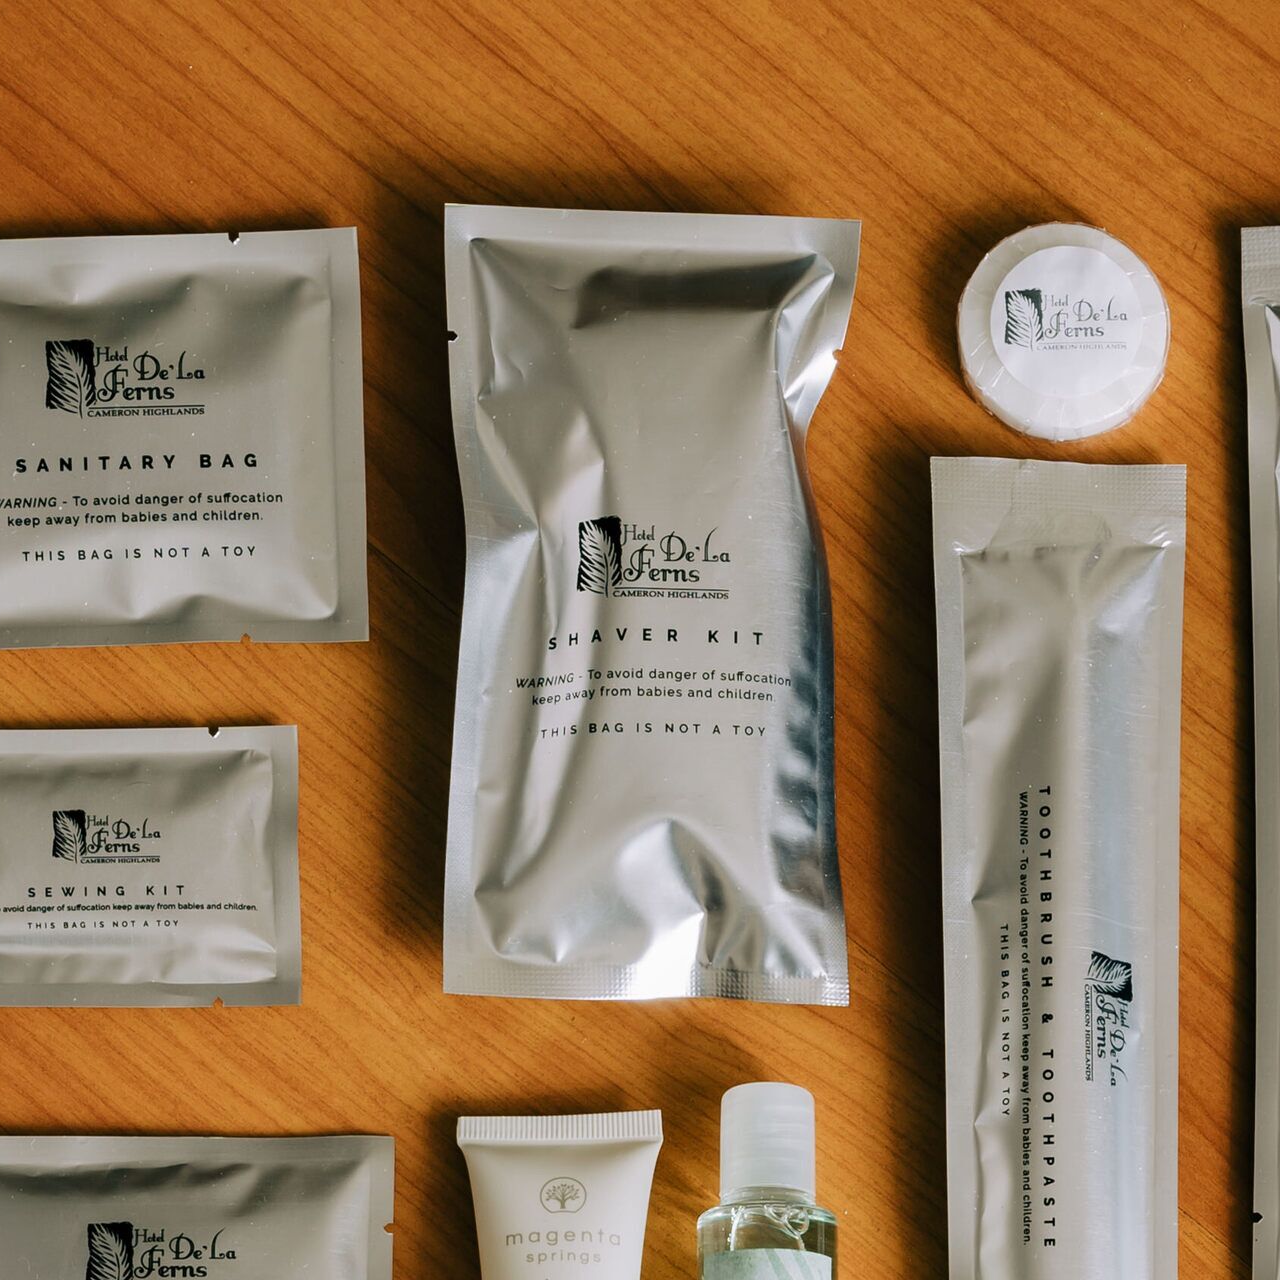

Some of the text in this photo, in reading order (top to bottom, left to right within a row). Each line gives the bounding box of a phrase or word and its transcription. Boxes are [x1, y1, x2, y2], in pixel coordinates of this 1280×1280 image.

[1044, 309, 1104, 339] Ferns
[94, 346, 128, 367] Hotel
[96, 364, 175, 402] Ferns
[86, 407, 205, 418] CAMERON HIGHLANDS
[15, 453, 258, 474] SANITARY BAG
[72, 495, 88, 507] To
[93, 493, 130, 506] avoid
[135, 493, 184, 508] danger
[188, 492, 202, 504] of
[206, 492, 283, 504] suffocation
[7, 510, 263, 528] keep away from babies and children.
[622, 523, 656, 546] Hotel
[22, 546, 256, 562] THIS BAG IS NOT A TOY
[622, 544, 700, 582] Ferns
[612, 589, 729, 600] CAMERON HIGHLANDS
[548, 628, 764, 650] SHAVER KIT
[516, 668, 792, 689] WARNING To avoid danger of suffocation
[532, 686, 776, 706] keep away from babies and children.
[540, 722, 766, 738] THIS BAG IS NOT A TOY
[86, 815, 109, 829] Hotel
[87, 827, 141, 854] Ferns
[28, 885, 184, 898] SEWING KIT
[63, 921, 86, 929] BAG
[112, 920, 136, 928] NOT
[1000, 924, 1009, 961] THIS
[1001, 970, 1010, 1000] BAG
[1002, 1009, 1010, 1023] IS
[1018, 791, 1031, 1246] WARNING To avoid danger of suffocation keep away from babies and children.
[1039, 786, 1055, 1247] TOOTHBRUSH & TOOTHPASTE
[1117, 1000, 1130, 1029] Hotel
[1096, 995, 1119, 1059] Ferns
[1002, 1032, 1010, 1062] NOT
[1002, 1088, 1010, 1116] TOY
[133, 1228, 165, 1248] Hotel
[505, 1228, 621, 1247] magenta
[134, 1244, 208, 1279] Ferns
[526, 1249, 601, 1265] springs
